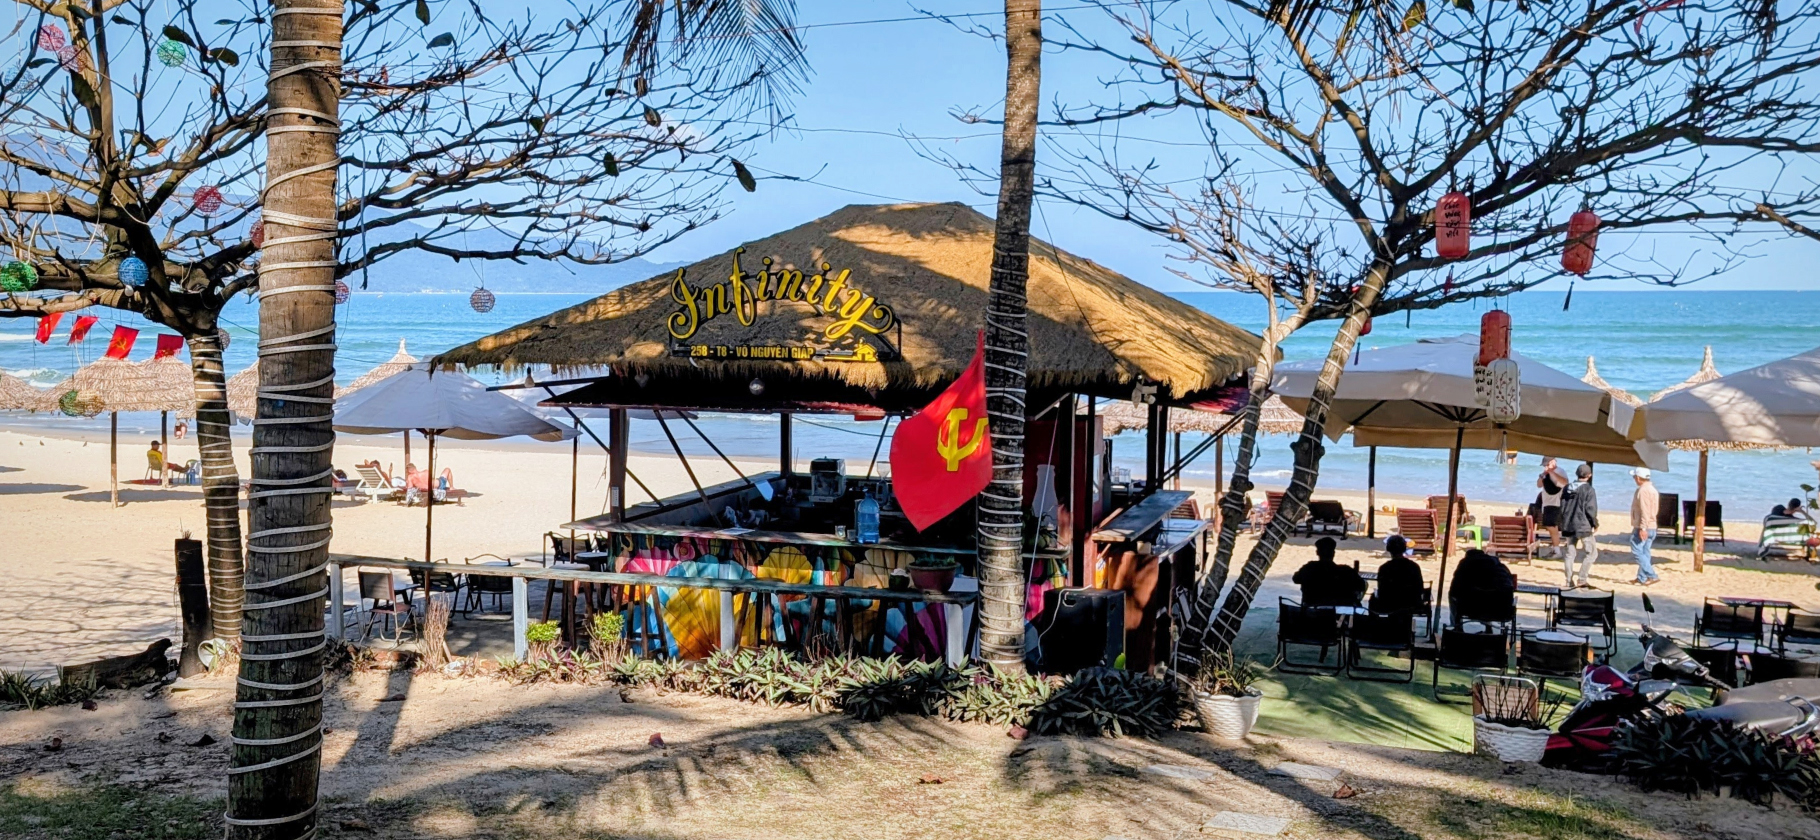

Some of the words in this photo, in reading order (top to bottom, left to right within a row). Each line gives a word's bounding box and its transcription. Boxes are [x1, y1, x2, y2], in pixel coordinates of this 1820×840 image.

[667, 246, 894, 340] Infinity
[690, 345, 708, 357] 258
[716, 345, 728, 357] T8
[791, 345, 814, 359] GIÁP
